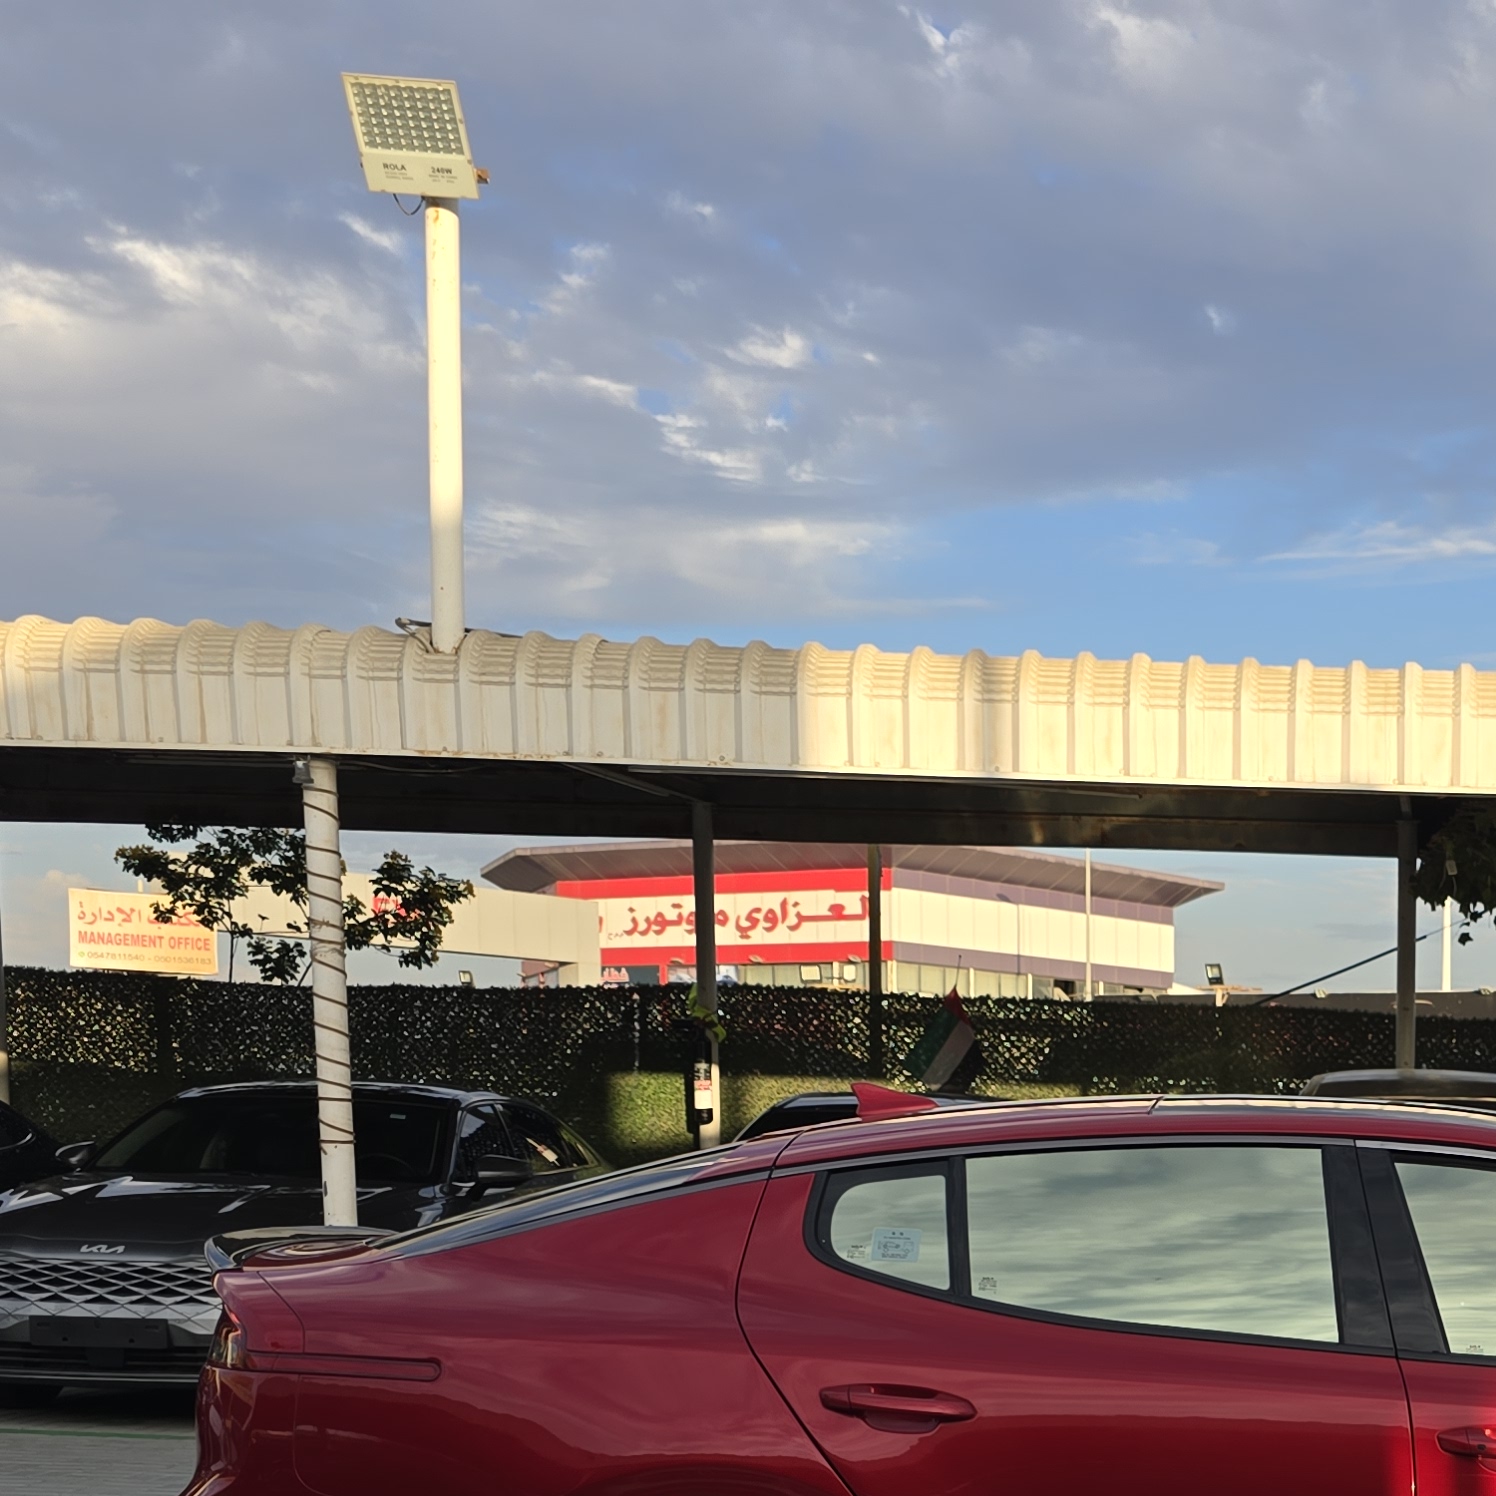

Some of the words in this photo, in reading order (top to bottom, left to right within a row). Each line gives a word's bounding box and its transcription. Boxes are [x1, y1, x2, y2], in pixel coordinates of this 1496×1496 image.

[382, 162, 407, 171] ROLA
[77, 901, 141, 927] الإدارة
[735, 894, 870, 939] لعزاوي
[78, 930, 164, 948] MANAGEMENT
[168, 936, 211, 951] OFFICE
